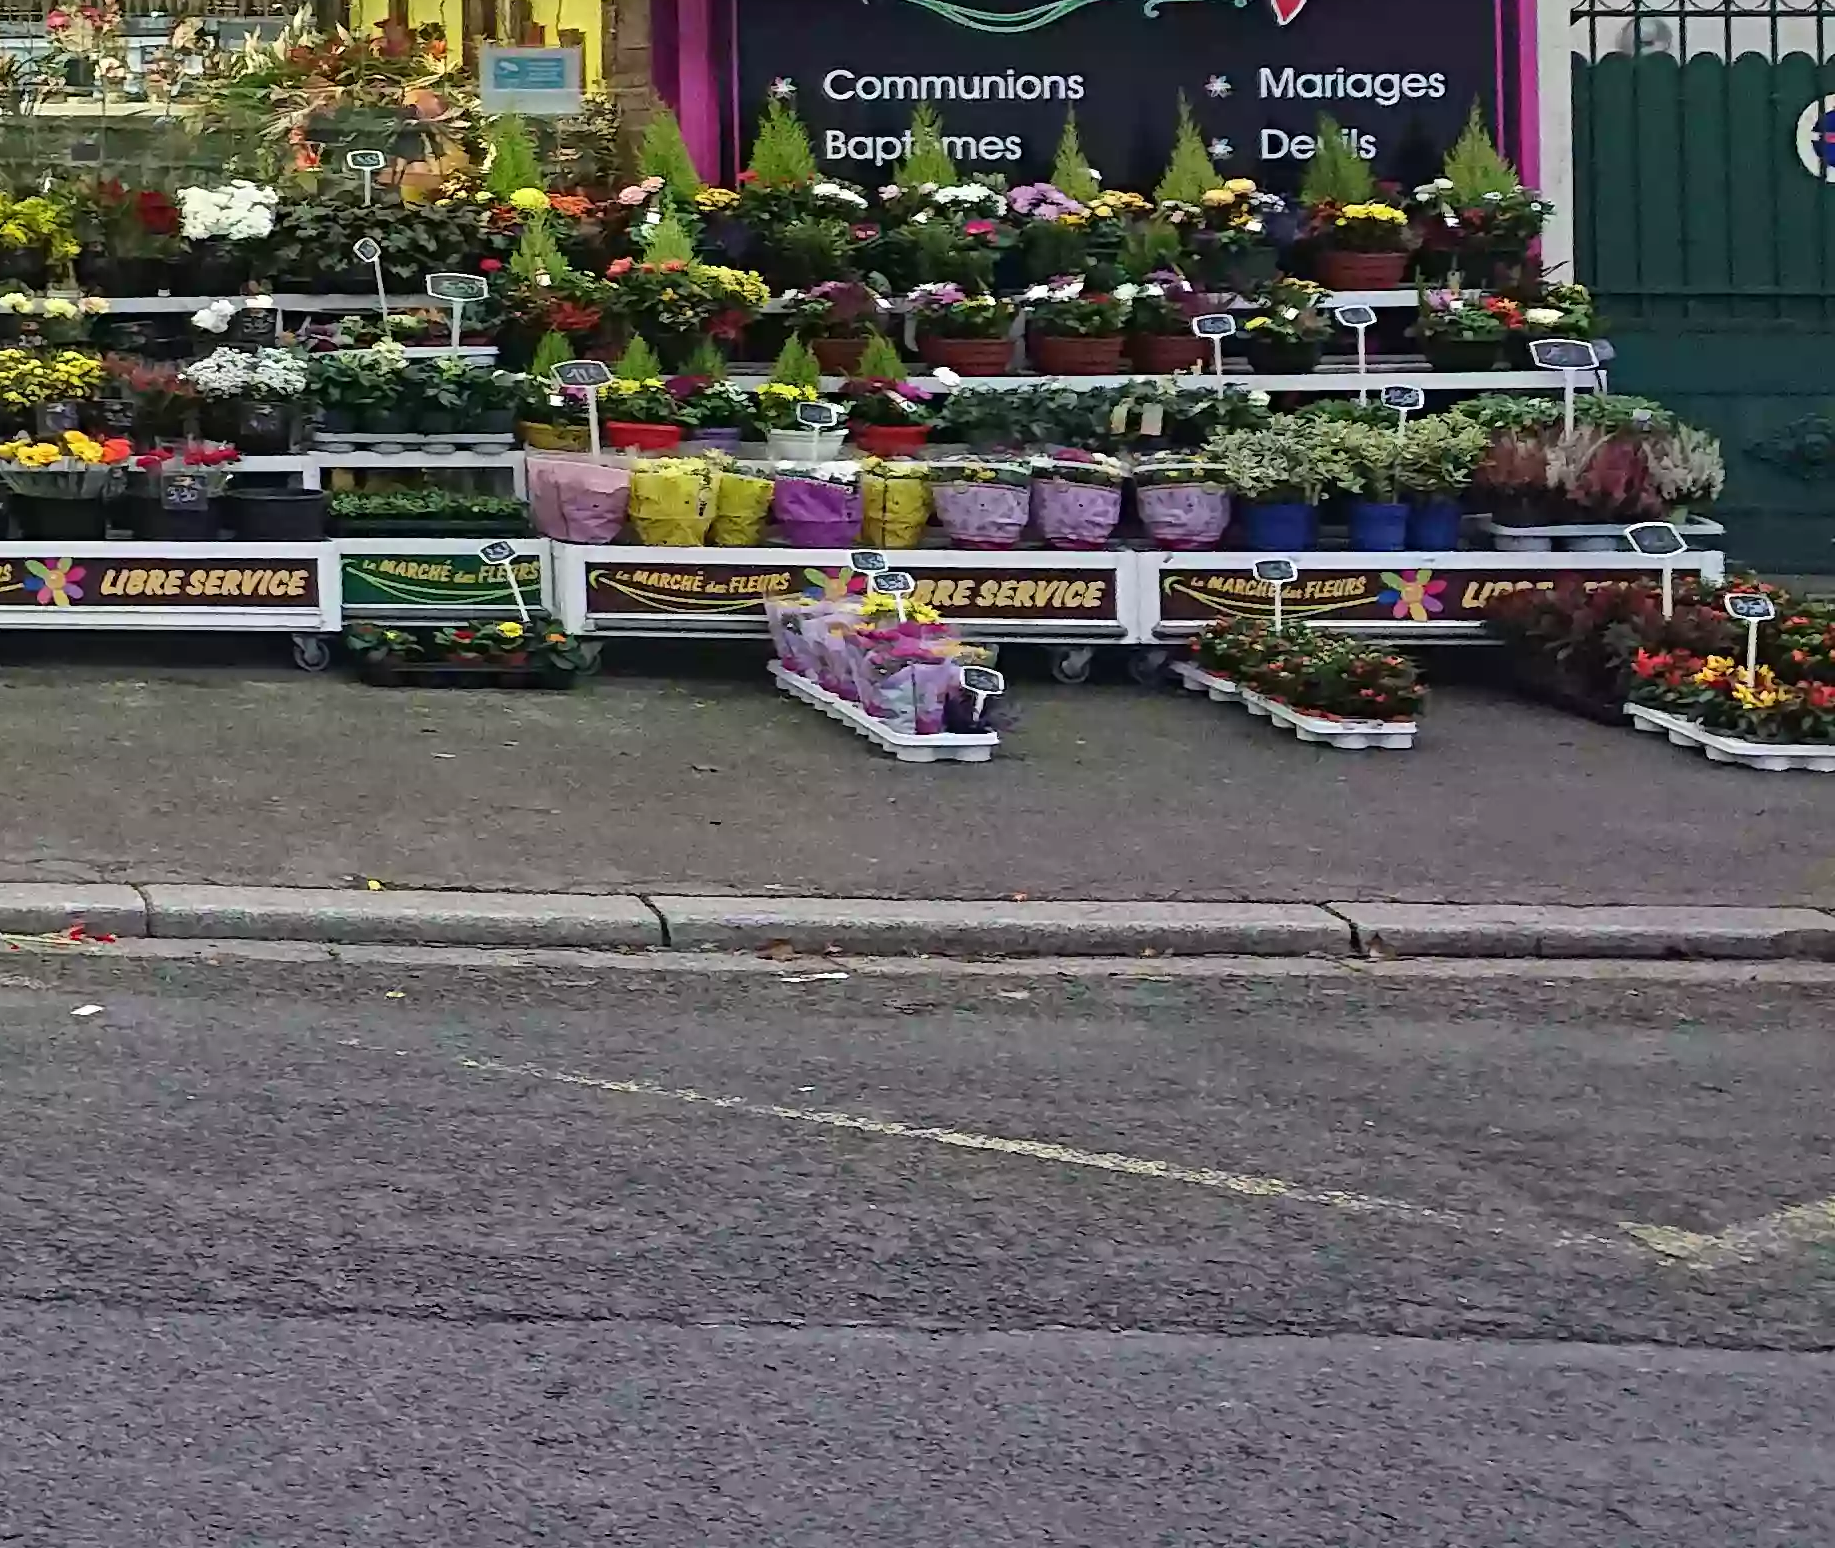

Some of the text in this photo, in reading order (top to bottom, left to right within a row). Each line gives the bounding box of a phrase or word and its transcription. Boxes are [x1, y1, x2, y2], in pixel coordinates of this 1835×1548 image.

[822, 68, 1086, 103] Communions
[1257, 67, 1446, 106] Mariages
[825, 129, 1022, 166] Baptmes
[1260, 128, 1377, 160] Deils
[99, 568, 310, 597] LIBRE SERVICE
[378, 558, 452, 583] MARCHÉ
[477, 557, 541, 583] FLEURS
[632, 568, 704, 593] MARCHÉ
[728, 571, 790, 594] FLEURS
[912, 579, 976, 606] BRE
[974, 579, 1106, 608] SERVICE
[1303, 575, 1367, 599] FLEURS
[1461, 581, 1555, 609] LIB
